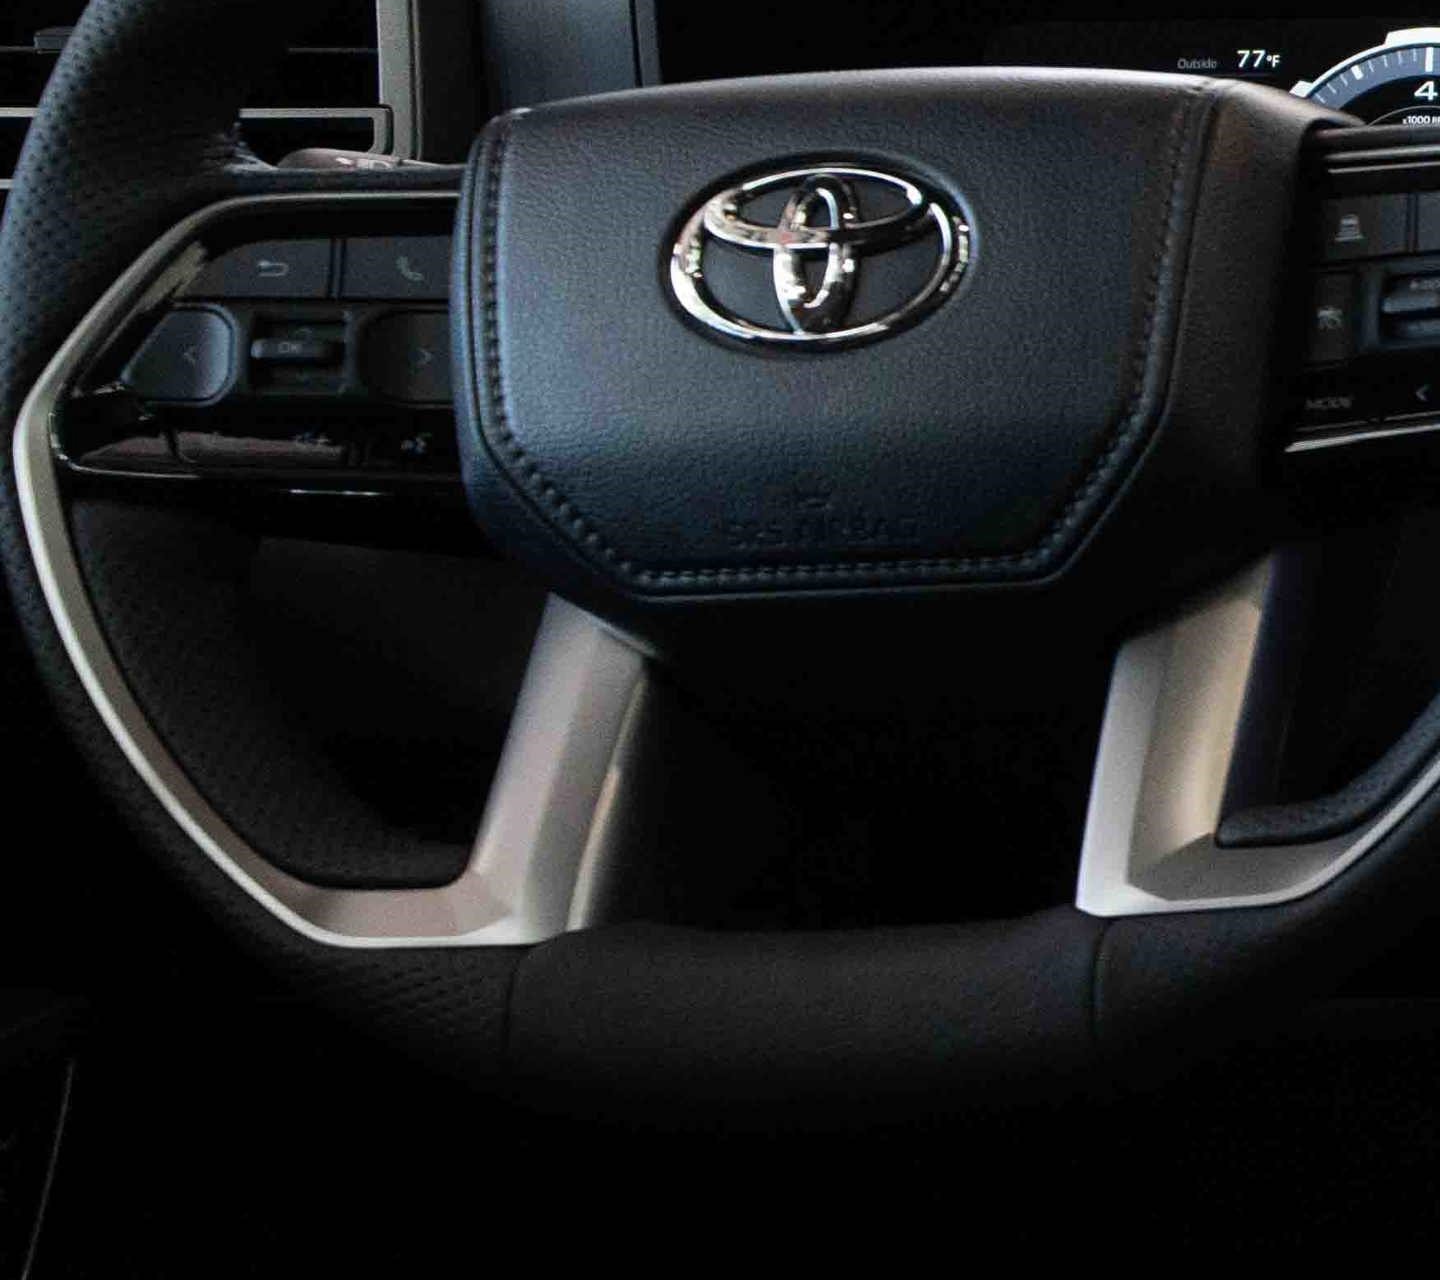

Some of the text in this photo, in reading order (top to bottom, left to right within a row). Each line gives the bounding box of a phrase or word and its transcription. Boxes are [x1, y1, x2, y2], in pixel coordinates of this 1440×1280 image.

[1177, 49, 1281, 70] Outside 77°F
[1413, 79, 1439, 101] 4
[1402, 115, 1430, 126] x1000
